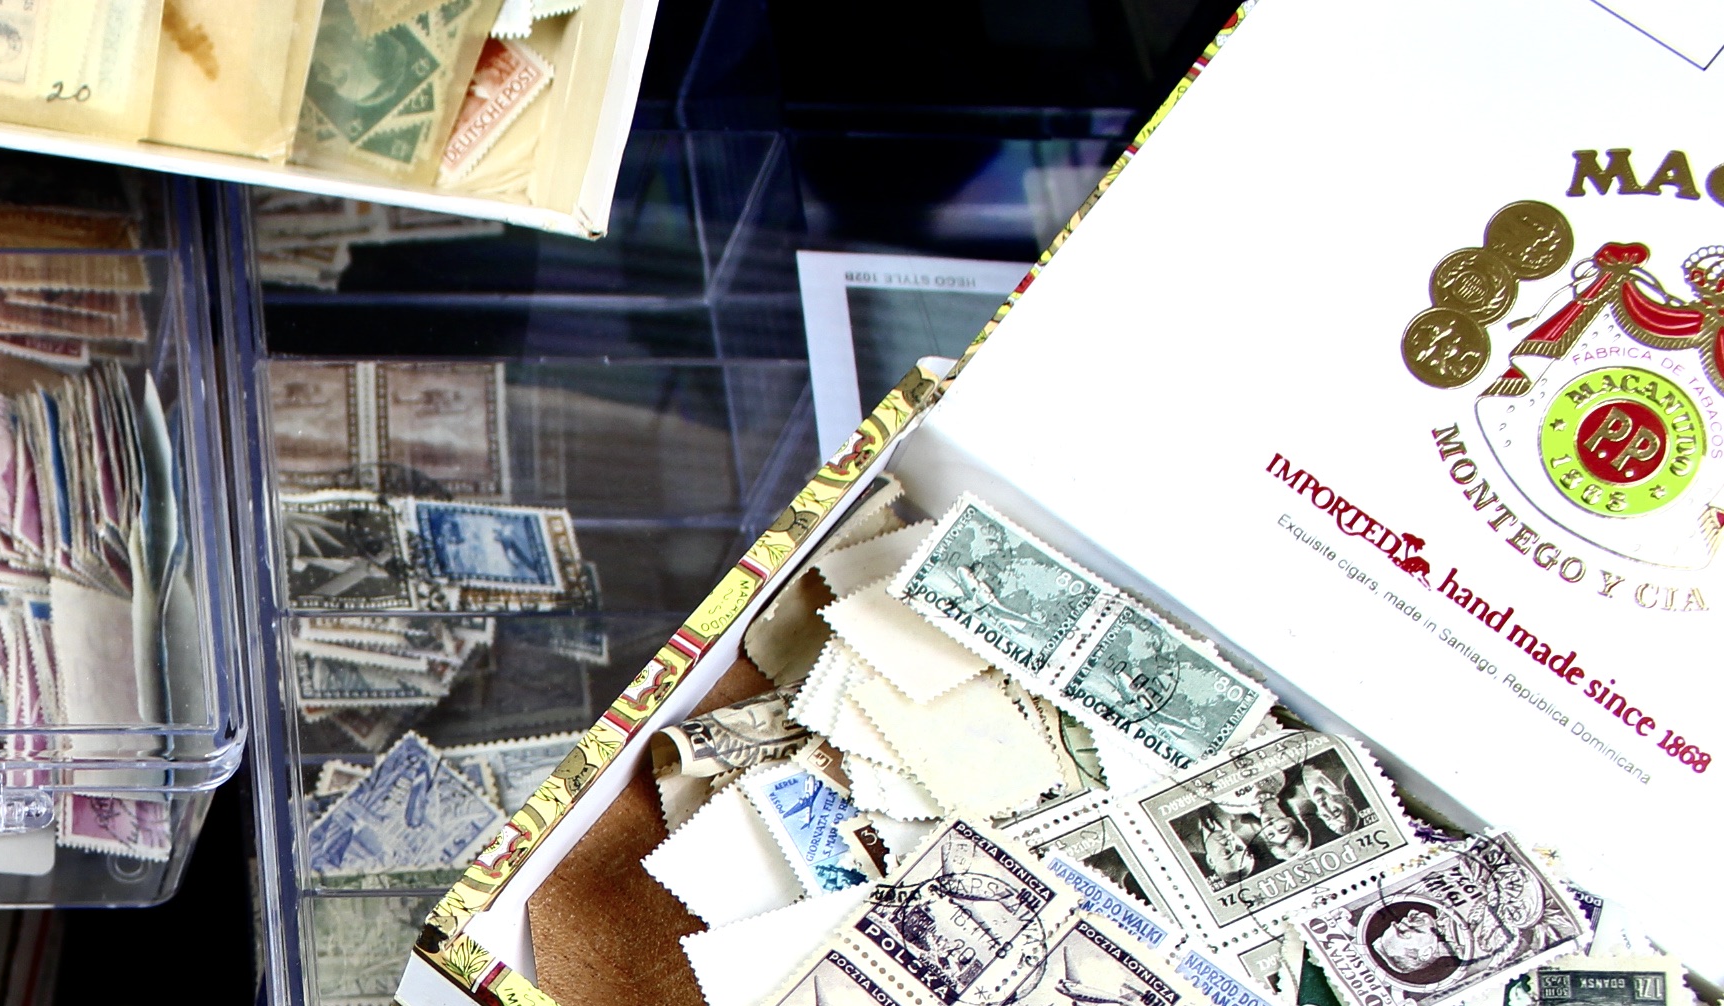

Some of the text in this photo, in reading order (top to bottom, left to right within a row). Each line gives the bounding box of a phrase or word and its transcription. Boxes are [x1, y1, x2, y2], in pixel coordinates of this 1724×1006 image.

[46, 81, 92, 103] 20
[444, 65, 537, 165] DEUTSCHE POST
[884, 272, 931, 284] STYLE
[1565, 373, 1697, 478] MACANUDO
[1573, 347, 1723, 460] FABRICA DE TABACOS
[1432, 422, 1710, 613] MONTEGO Y CIA
[1056, 571, 1086, 597] 80
[915, 584, 972, 628] POCZTA
[975, 624, 1036, 670] POLSKA
[1265, 453, 1713, 775] IMPORTED hand made since 1868
[1276, 513, 1652, 785] Exquisite cigars, made in Santiago, República Dominicana
[1075, 689, 1132, 733] POCZTA
[1213, 675, 1245, 702] 80
[769, 792, 786, 815] POSTA
[773, 777, 799, 791] AEREA
[806, 812, 830, 862] GIORNATA
[955, 823, 1052, 901] POCZTA LOTNICZA
[1257, 847, 1359, 900] POLSKA
[1121, 909, 1165, 946] WALKI
[827, 950, 872, 991] POCZTA
[863, 923, 949, 1001] POLSKA
[1079, 922, 1124, 961] POCZTA
[1122, 953, 1176, 1001] LOTNICZA
